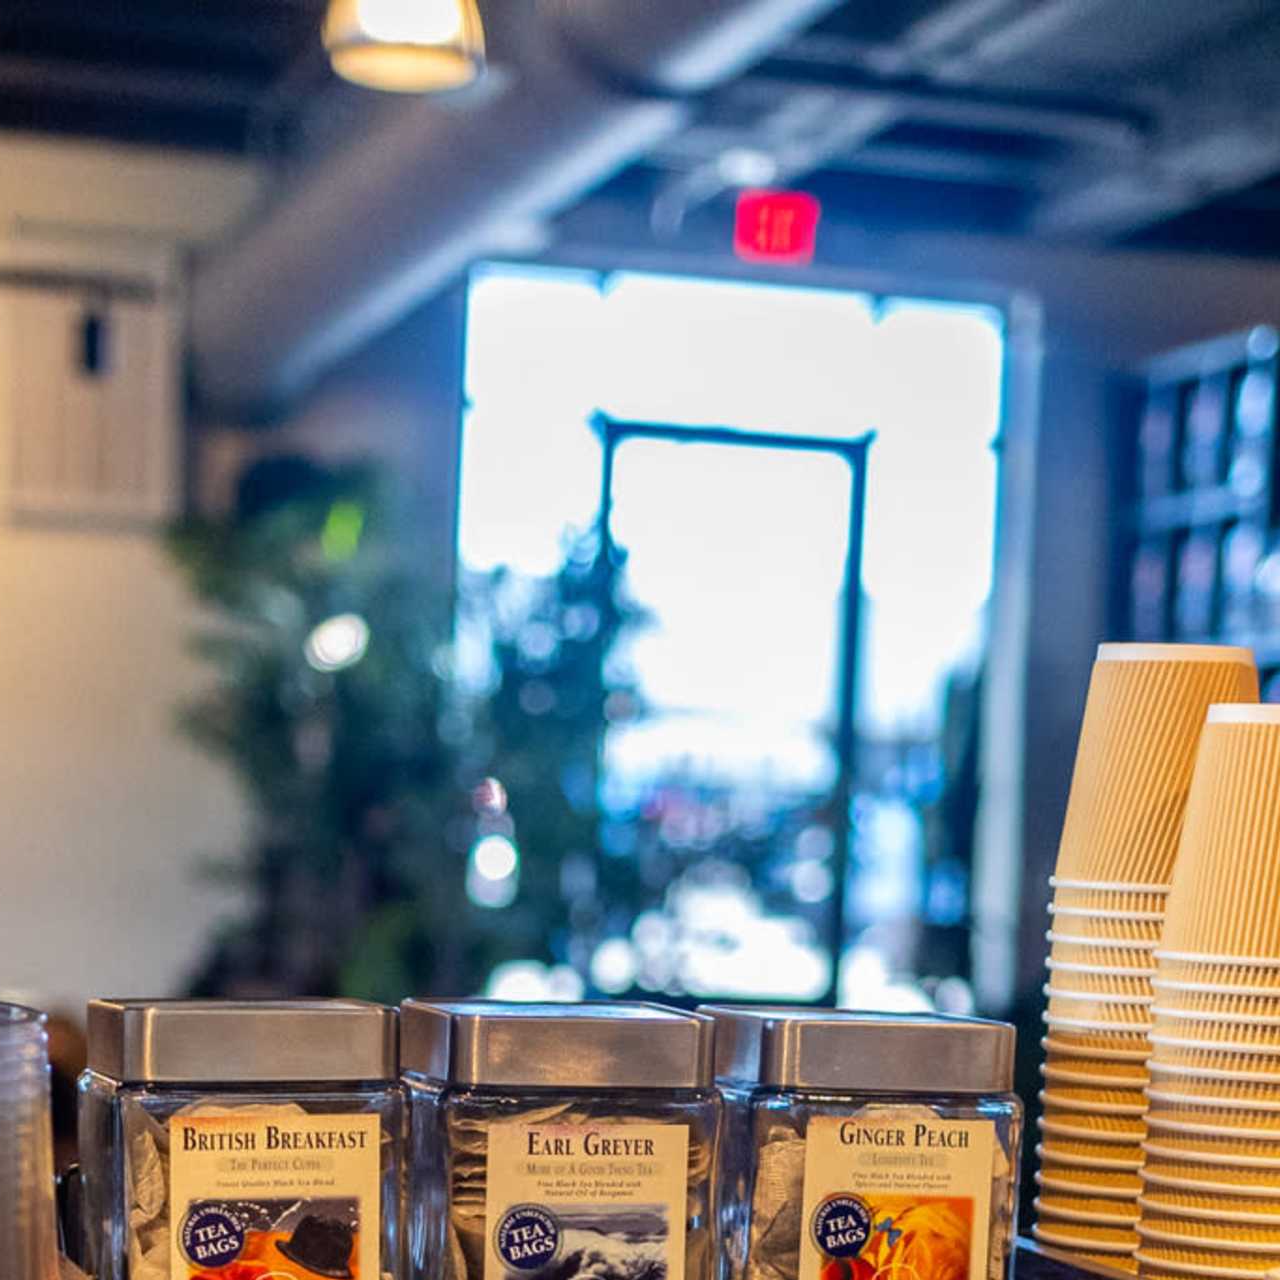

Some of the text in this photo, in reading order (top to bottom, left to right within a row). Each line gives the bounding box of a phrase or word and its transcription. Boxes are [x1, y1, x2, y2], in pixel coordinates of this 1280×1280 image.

[183, 1126, 368, 1151] BRITISH BREAKFAST
[528, 1132, 654, 1156] EARL GREYER
[840, 1122, 969, 1148] GINGER PEACH
[195, 1223, 229, 1242] TEA
[508, 1223, 544, 1243] TEA
[826, 1214, 857, 1232] TEA
[195, 1235, 240, 1260] BAGS
[509, 1236, 554, 1260] BAGS
[826, 1227, 866, 1248] BAGS
